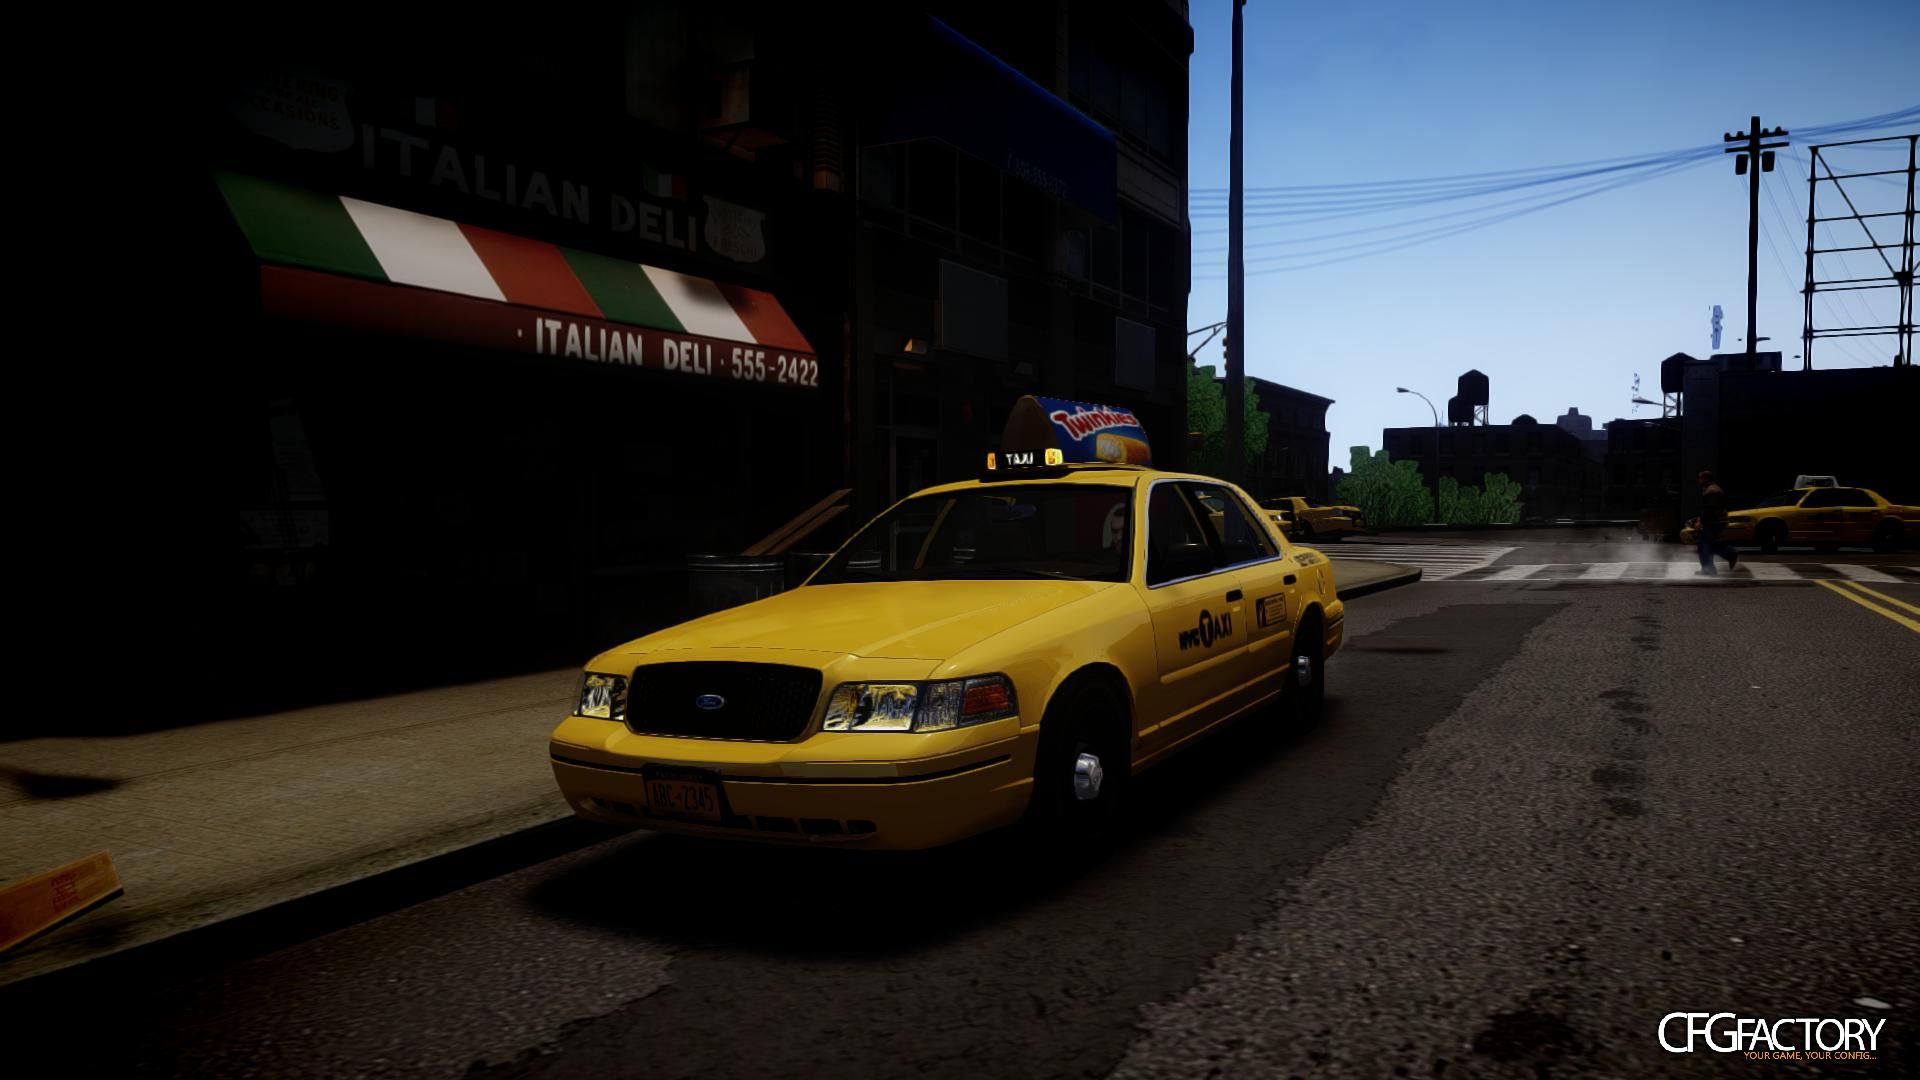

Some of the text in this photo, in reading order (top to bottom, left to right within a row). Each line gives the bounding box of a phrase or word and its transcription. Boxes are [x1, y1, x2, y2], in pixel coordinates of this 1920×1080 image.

[361, 121, 590, 224] ITALIAN
[611, 193, 697, 252] DELI
[535, 316, 819, 389] ITALIAN DELI 555-2422
[1051, 405, 1141, 441] Twinkies
[1006, 452, 1034, 465] TAXI
[1200, 610, 1233, 647] TAXI
